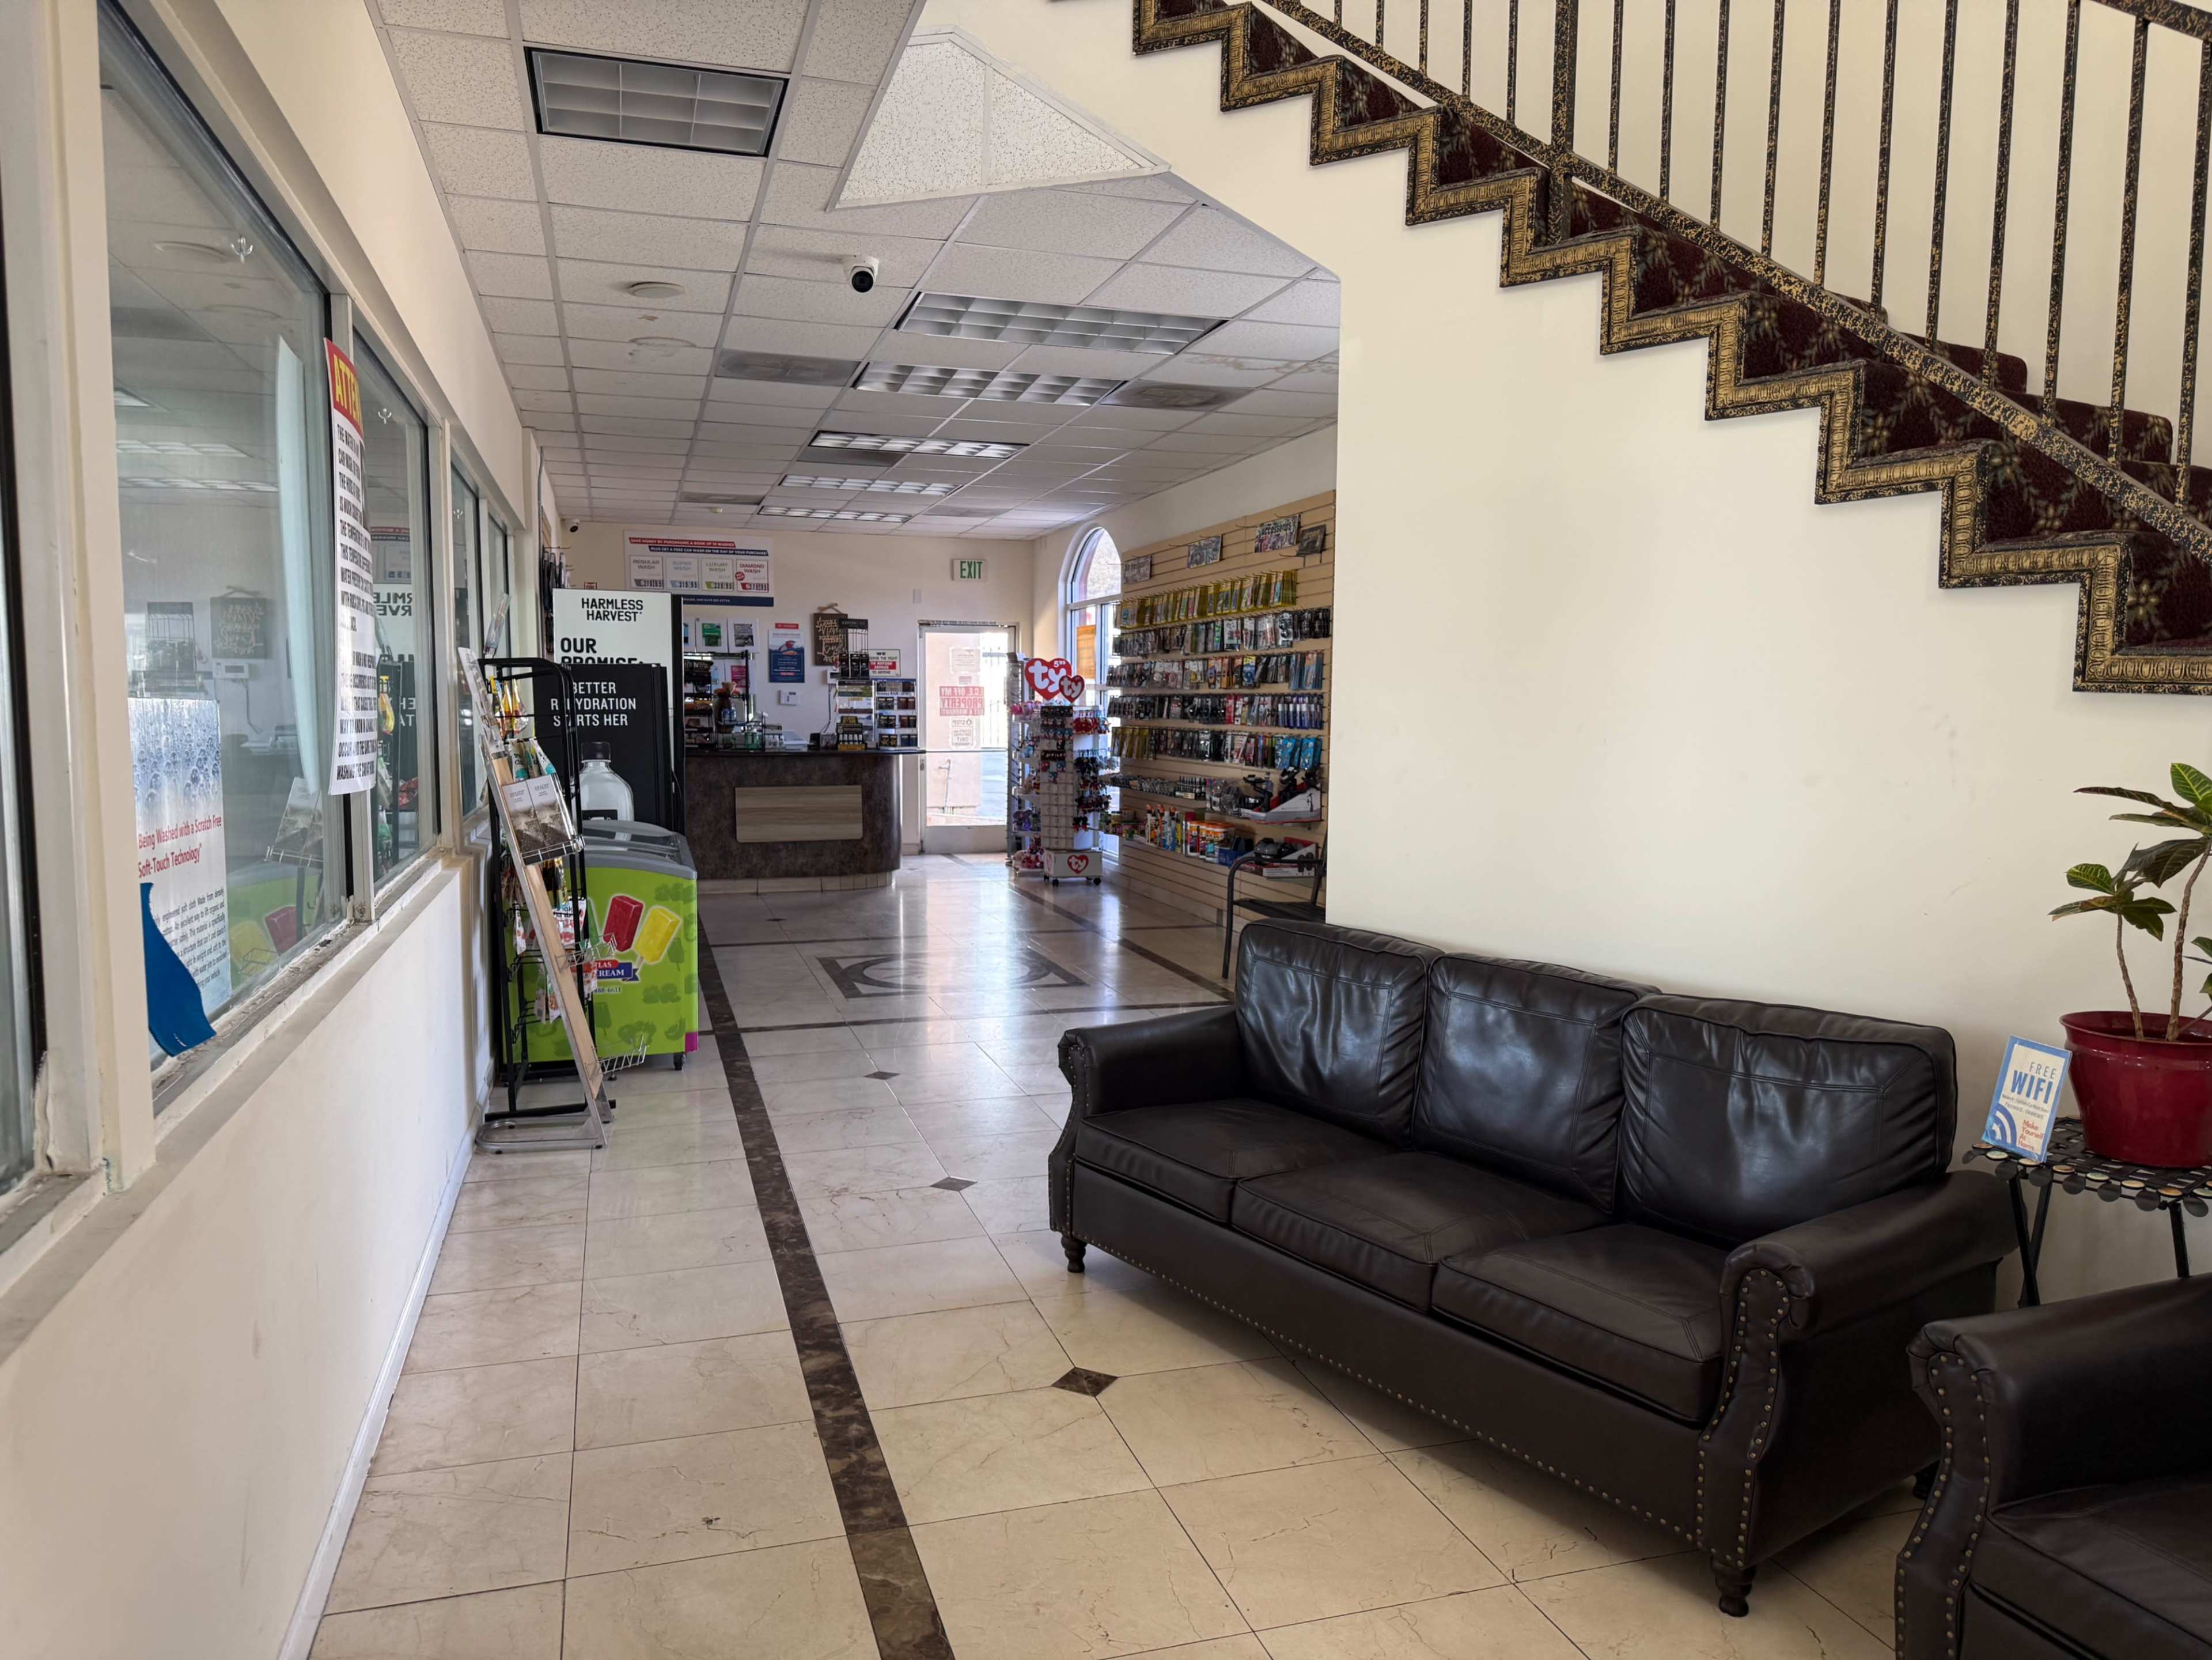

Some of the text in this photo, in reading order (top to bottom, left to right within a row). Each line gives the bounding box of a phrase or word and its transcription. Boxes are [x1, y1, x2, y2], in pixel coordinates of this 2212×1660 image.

[960, 561, 983, 579] EXIT
[581, 598, 643, 610] HARMLESS
[586, 610, 637, 622] HARVEST
[560, 637, 597, 653] OUR
[1028, 660, 1067, 693] ty
[1060, 677, 1082, 698] ty
[551, 698, 636, 710] RYDRATION
[553, 714, 628, 727] SRTS HER
[138, 815, 222, 850] Being Washed with a Scratch Free
[138, 853, 170, 878] Soft-Touch
[2029, 1061, 2057, 1079] FREE
[2010, 1069, 2053, 1104] WIFI
[2022, 1126, 2044, 1140] Yourself
[2023, 1120, 2039, 1130] Make
[2020, 1133, 2026, 1141] At
